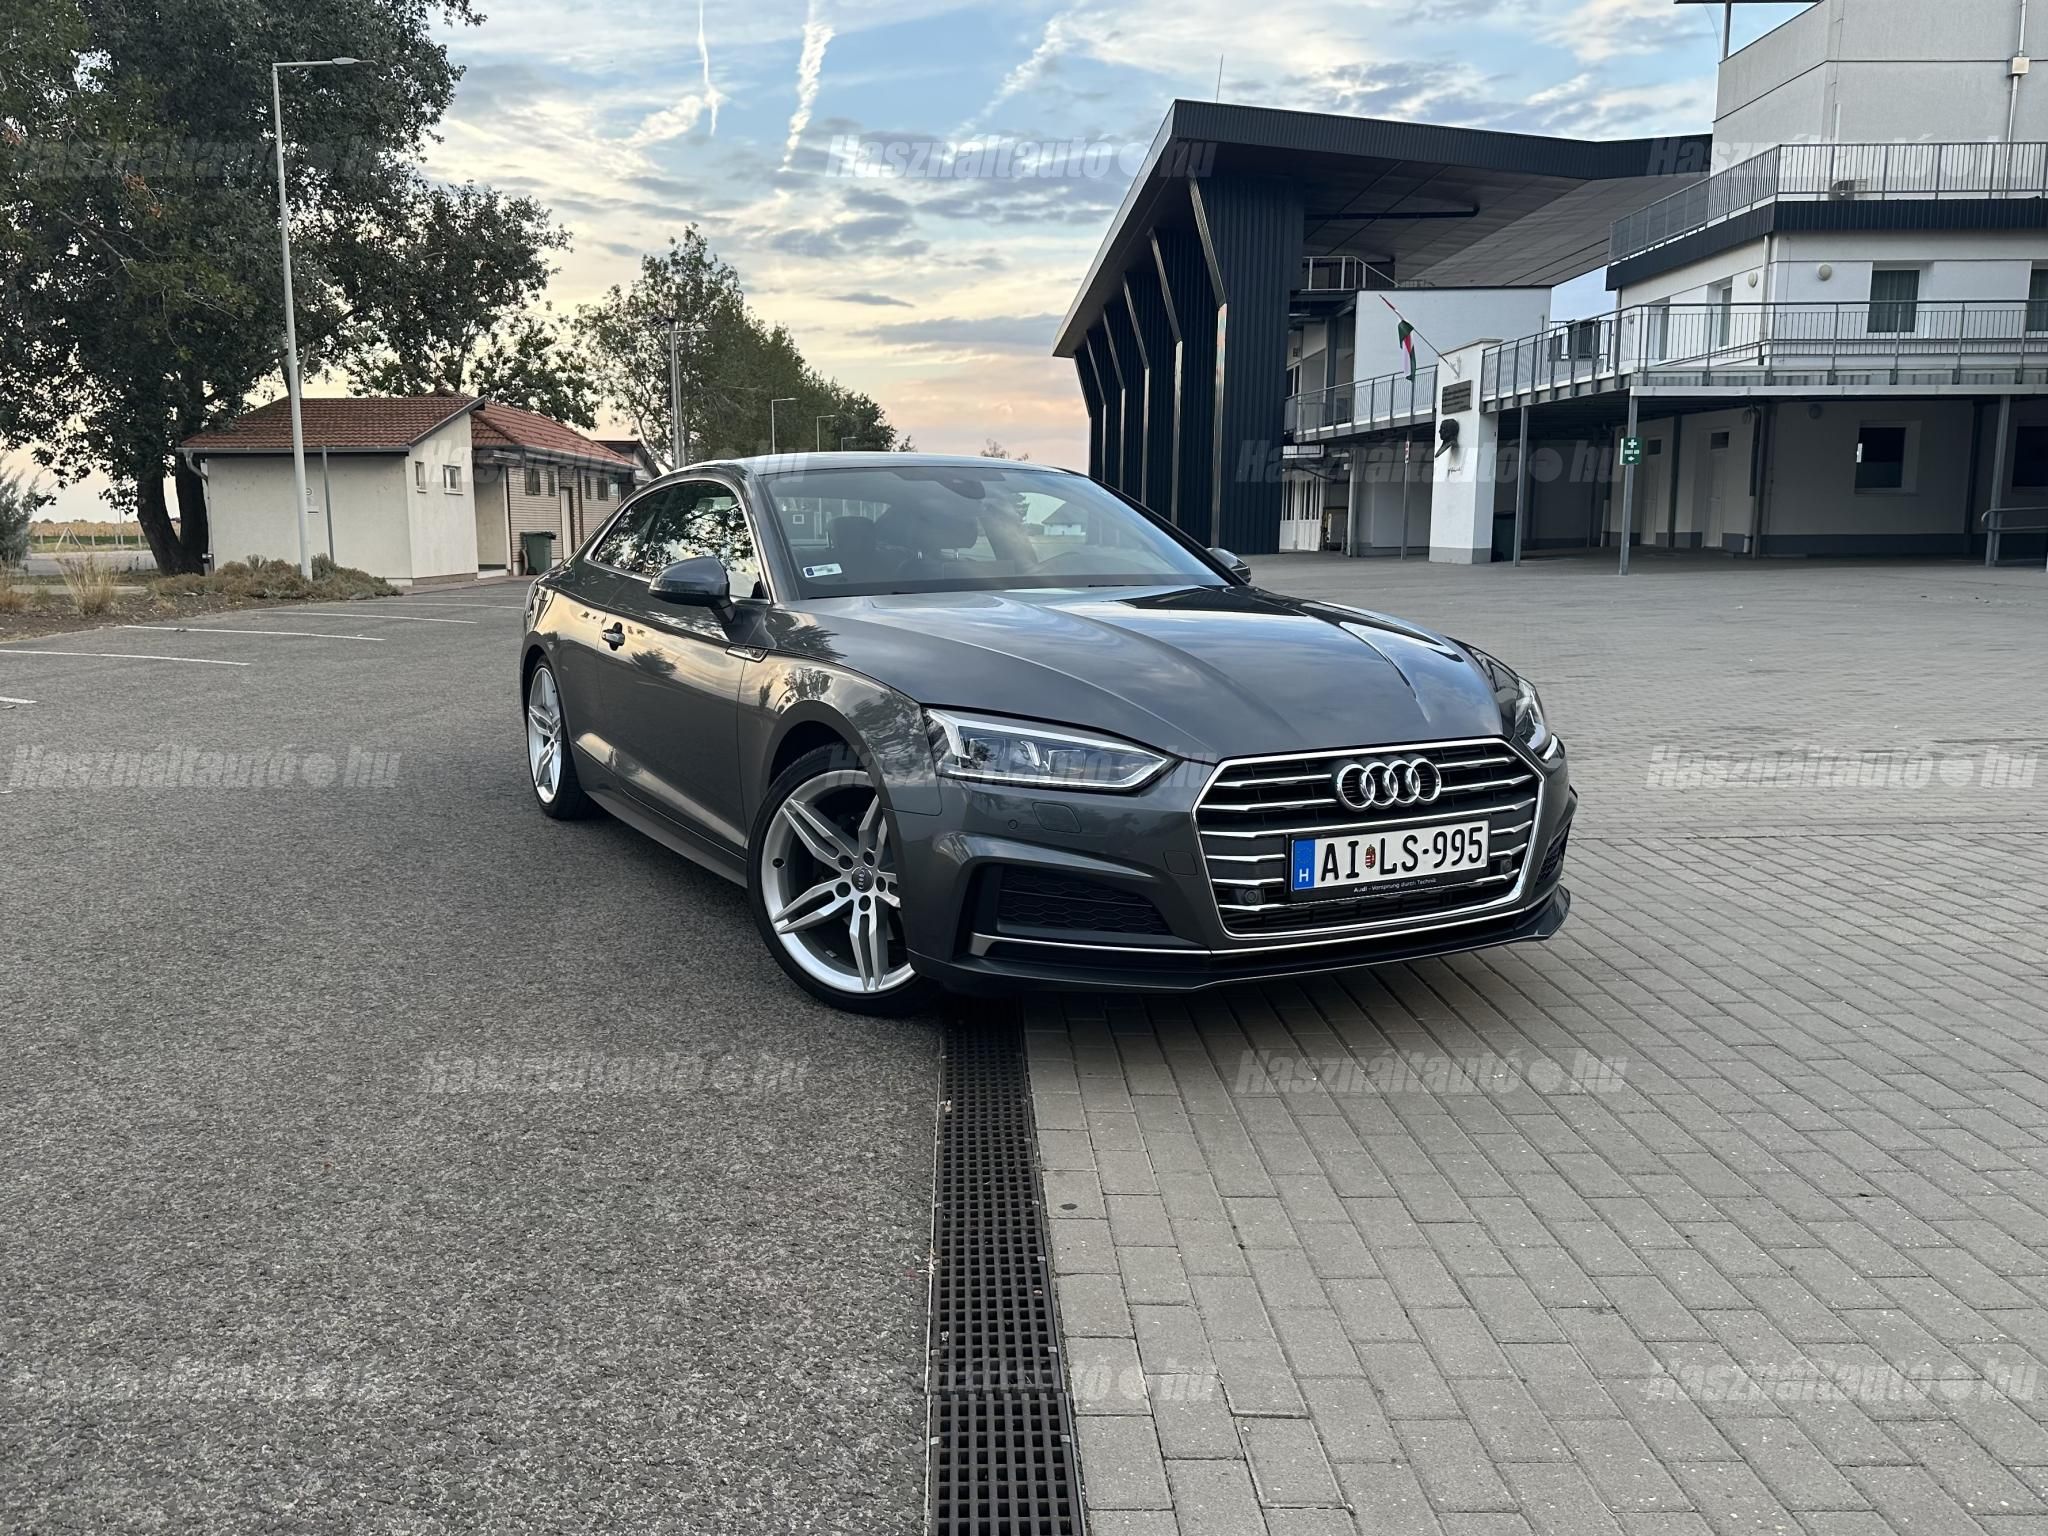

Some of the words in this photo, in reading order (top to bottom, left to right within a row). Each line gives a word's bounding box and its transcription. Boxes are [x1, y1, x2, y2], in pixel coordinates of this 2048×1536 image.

[1320, 840, 1360, 882] AI
[1379, 826, 1484, 876] LS-995
[1299, 868, 1309, 883] H
